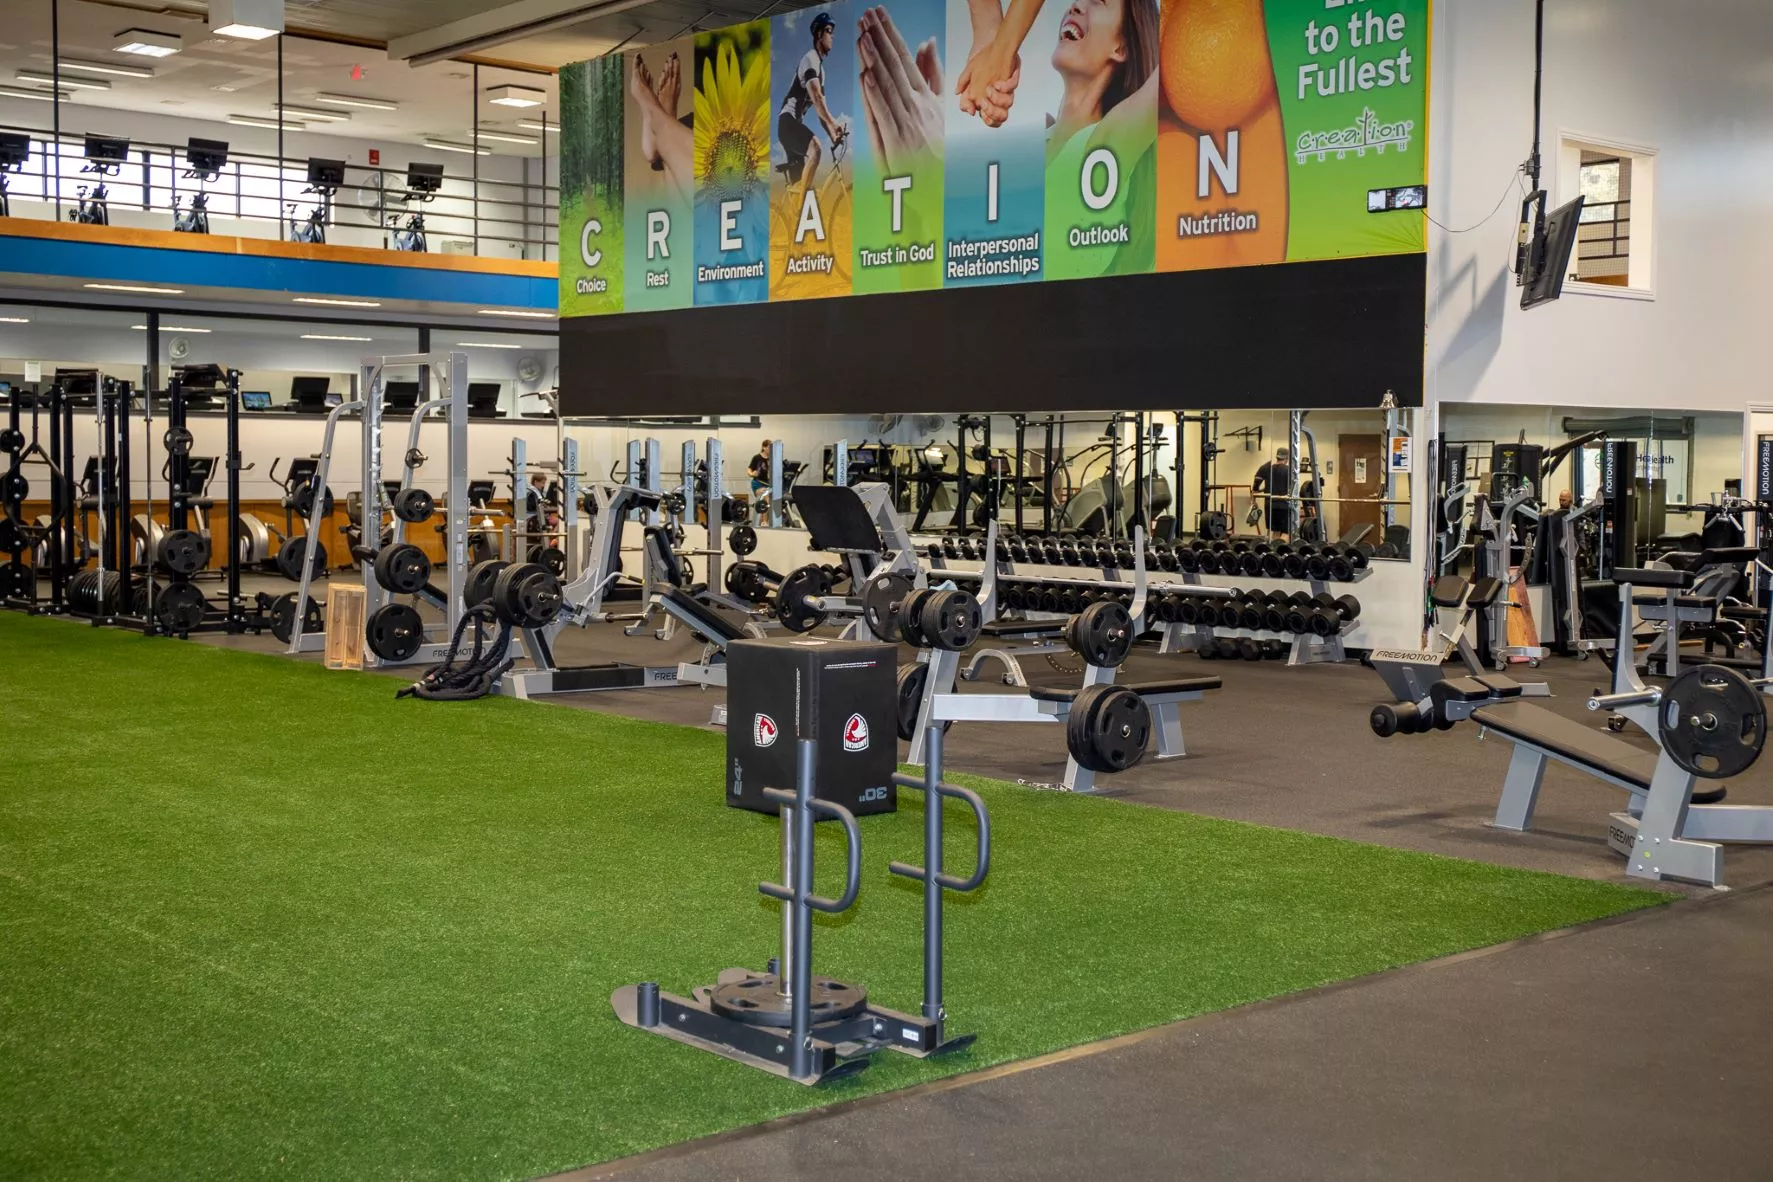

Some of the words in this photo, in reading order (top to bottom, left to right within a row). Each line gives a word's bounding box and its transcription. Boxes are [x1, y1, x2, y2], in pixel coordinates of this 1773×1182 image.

[1304, 19, 1339, 56] to
[1347, 8, 1406, 48] the
[1297, 46, 1412, 100] Fullest
[580, 219, 602, 267] C
[646, 210, 671, 260] R
[719, 199, 744, 252] E
[794, 189, 826, 244] A
[883, 175, 912, 232] T
[987, 163, 999, 222] I
[1080, 148, 1119, 210] O
[1197, 130, 1239, 198] N
[1069, 223, 1129, 247] Outlook
[1179, 211, 1257, 237] Nutrition
[860, 247, 893, 267] Trust
[895, 247, 908, 264] in
[909, 243, 935, 262] God
[947, 232, 1039, 259] Interpersonal
[697, 260, 765, 283] Environment
[786, 254, 834, 274] Activity
[947, 254, 1041, 279] Relationships
[576, 278, 607, 294] Choice
[646, 271, 669, 288] Rest
[1762, 441, 1770, 495] FREEMOTION
[1376, 650, 1438, 662] FREEMOTION
